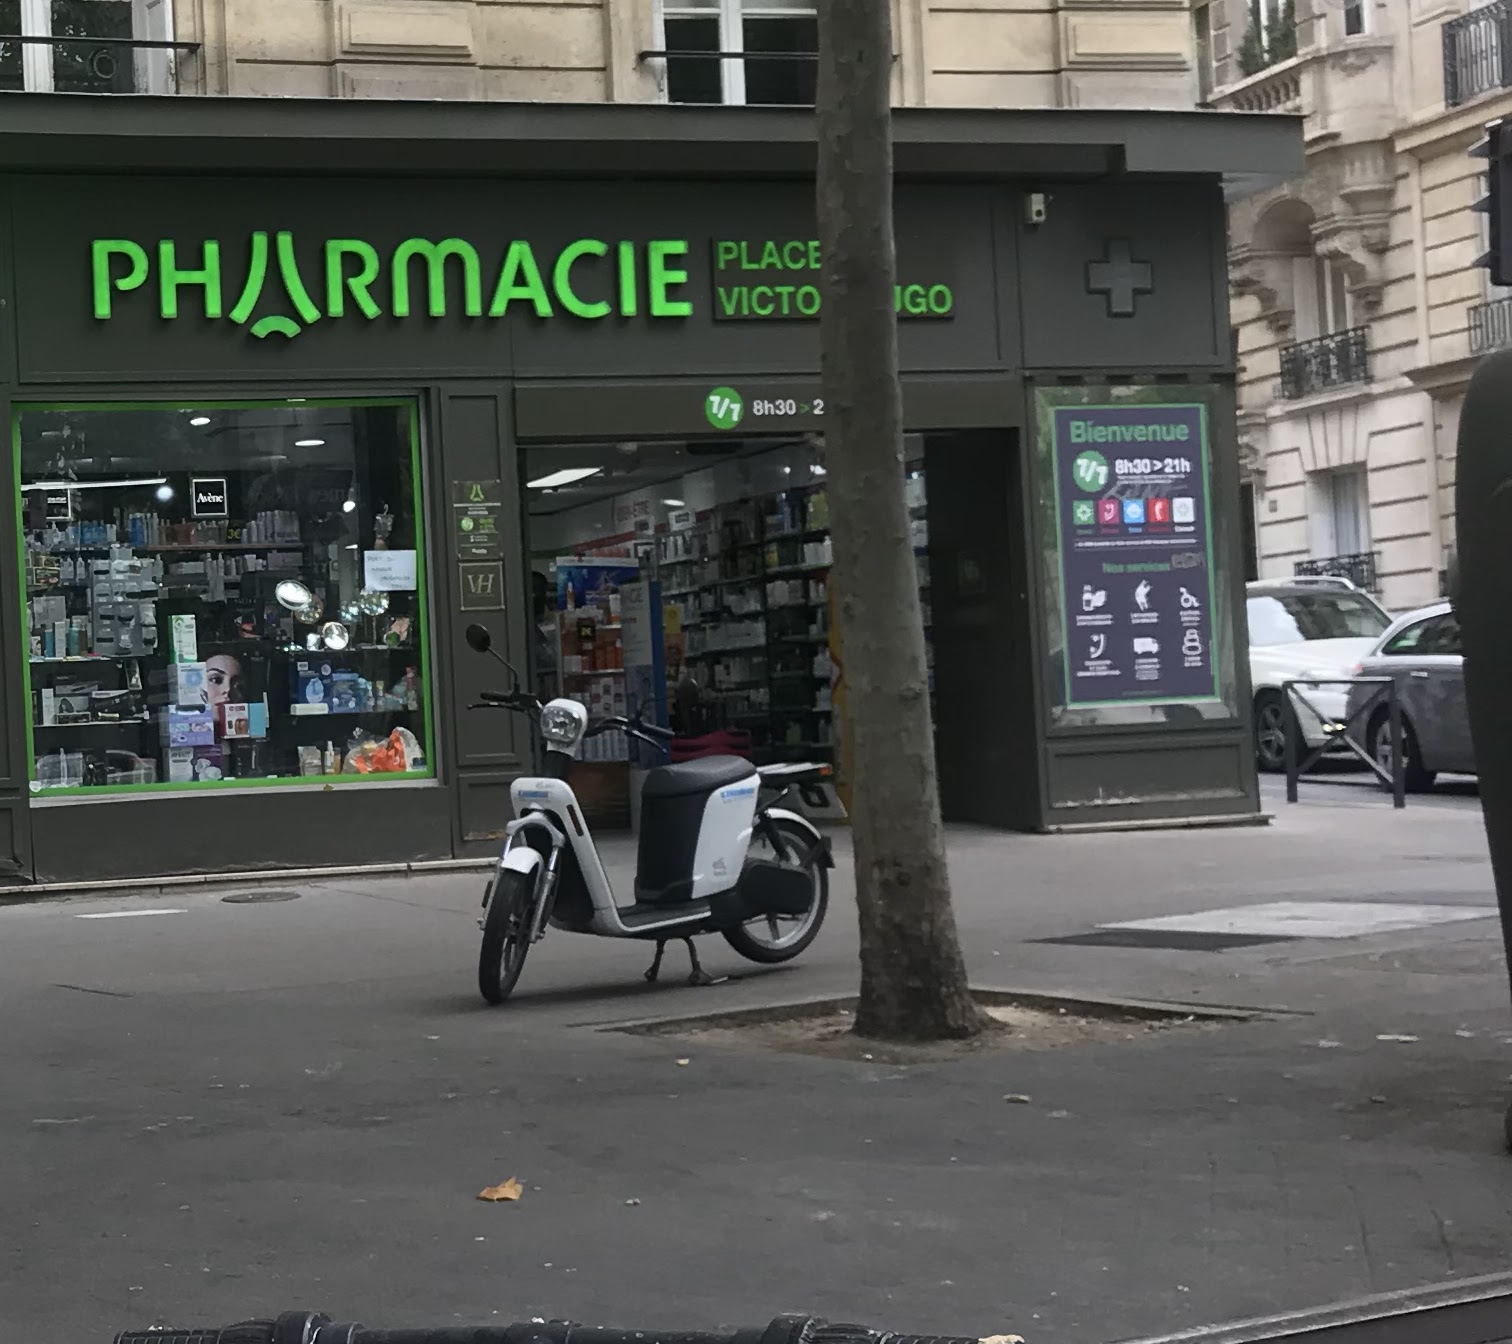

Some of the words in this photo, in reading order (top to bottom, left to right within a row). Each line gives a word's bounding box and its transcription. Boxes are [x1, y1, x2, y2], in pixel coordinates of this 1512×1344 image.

[717, 240, 821, 270] PLACE
[92, 231, 693, 338] PHARMACIE
[717, 285, 821, 315] VICTO
[753, 399, 796, 415] 8h30
[1069, 420, 1190, 443] Bienvenue
[196, 492, 224, 503] Avène
